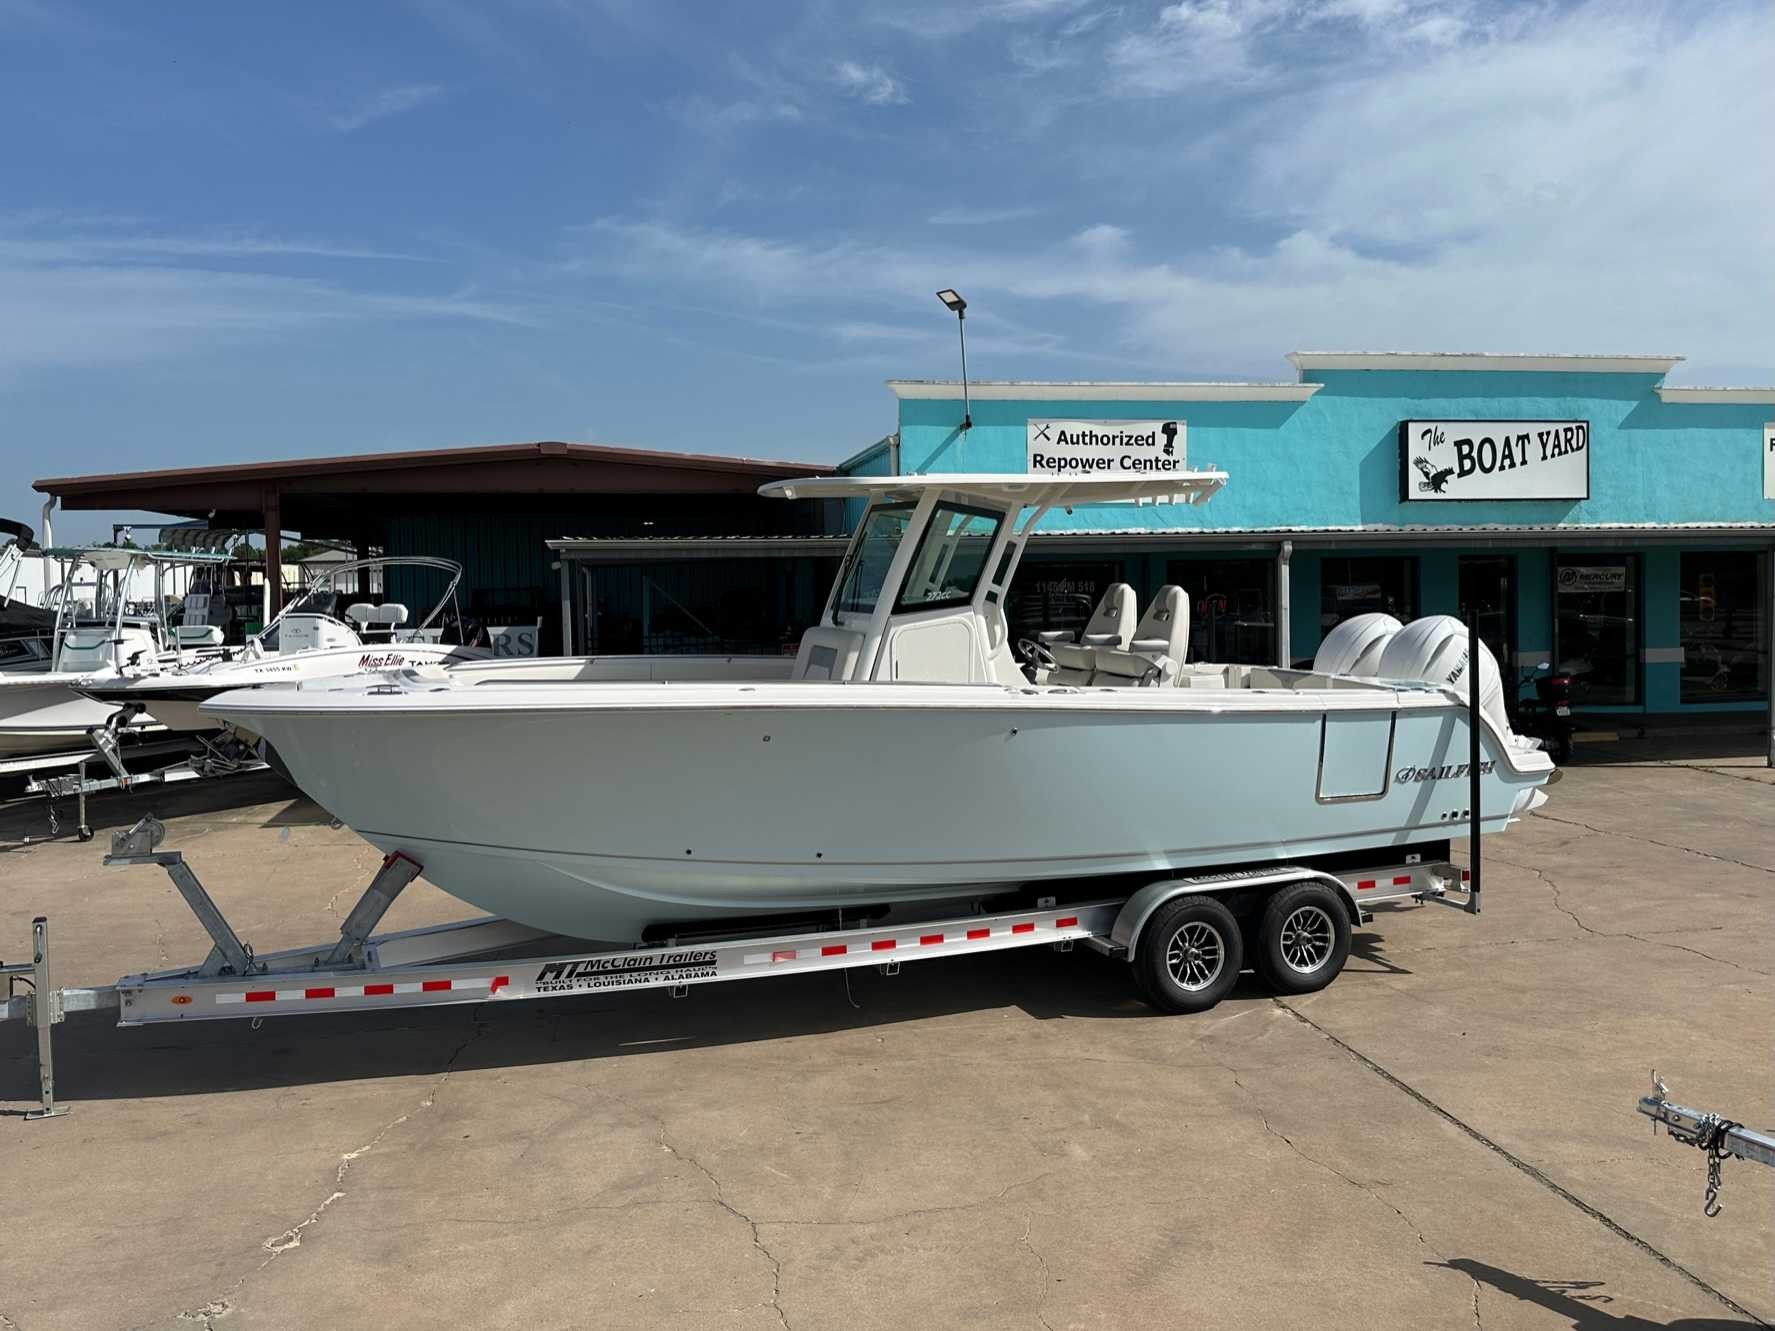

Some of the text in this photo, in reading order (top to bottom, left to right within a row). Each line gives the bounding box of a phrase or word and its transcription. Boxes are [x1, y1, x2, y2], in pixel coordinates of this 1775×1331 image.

[1056, 430, 1156, 446] Authorized
[1421, 425, 1445, 451] The
[1032, 453, 1180, 471] Repower Center
[1453, 425, 1586, 479] BOAT YARD
[358, 653, 405, 667] Miss Ellie
[584, 957, 653, 971] McClain
[660, 950, 717, 964] Trailers
[536, 970, 718, 992] TEXAS LOUISIANA ALABAMA
